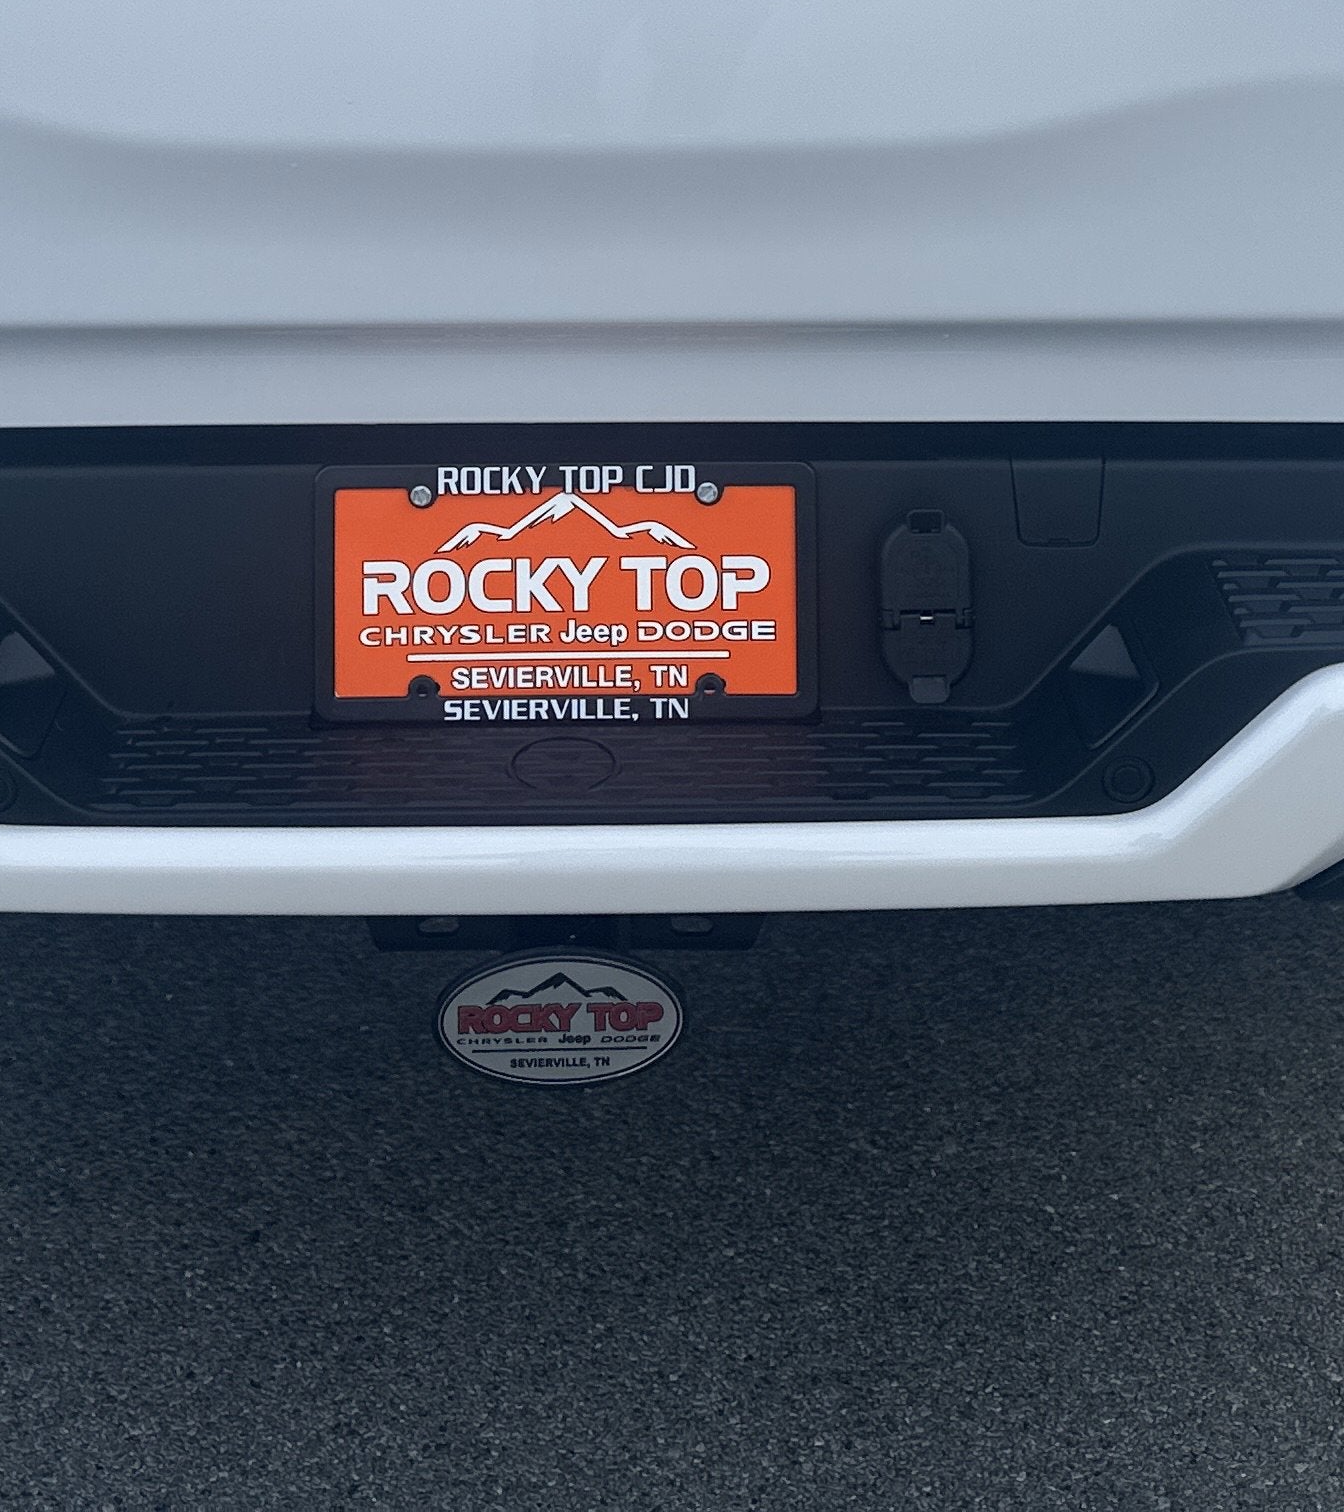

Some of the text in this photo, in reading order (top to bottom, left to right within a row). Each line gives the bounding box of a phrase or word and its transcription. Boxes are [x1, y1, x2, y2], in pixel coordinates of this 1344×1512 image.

[437, 464, 696, 496] ROCKY TOP CJD
[362, 555, 772, 616] ROCKY TOP
[358, 620, 777, 647] CHRYSLER Jeep DODGE
[451, 665, 690, 691] SEVIERVILLE, TN
[443, 698, 690, 723] SEVIERVILLE, TN
[457, 1002, 664, 1035] ROCKY TOP
[456, 1033, 661, 1046] CHRYSLER Jeep DODGE
[510, 1056, 611, 1069] SEVIERVILLE, TN
